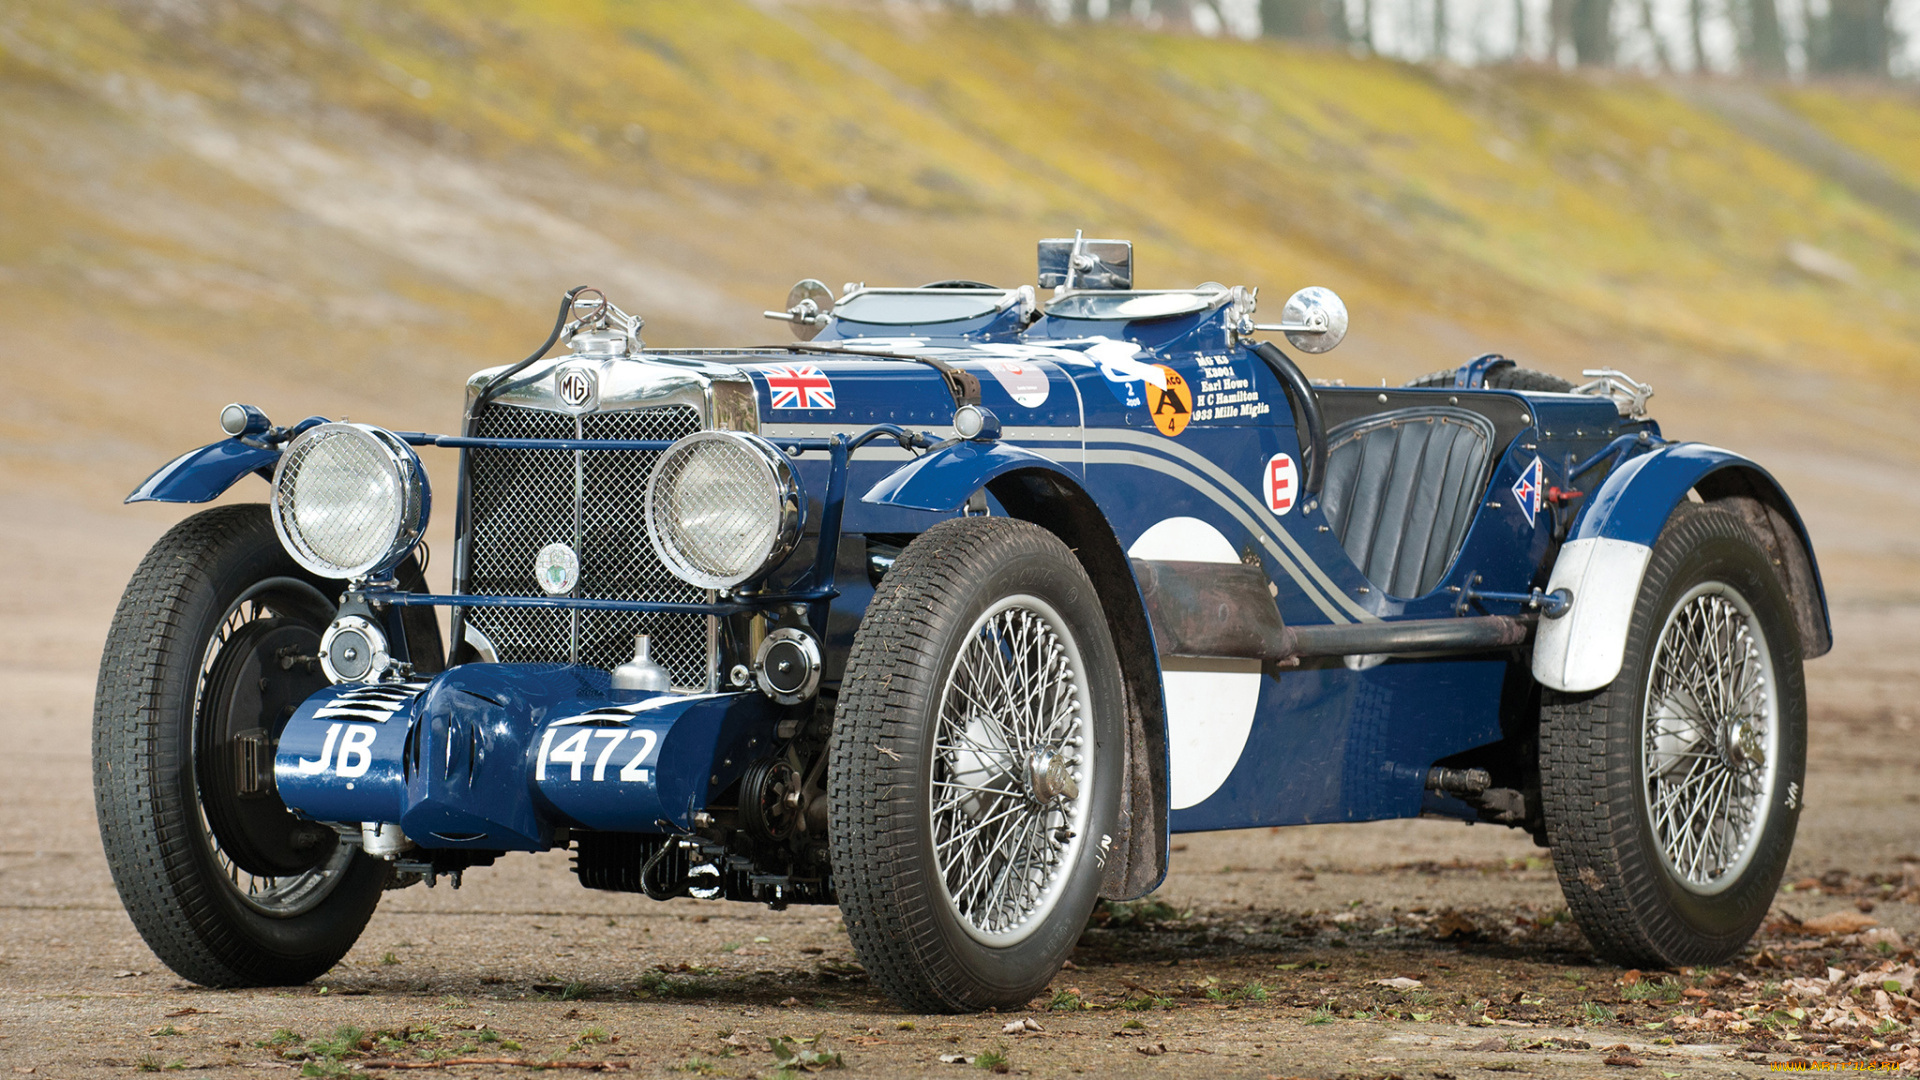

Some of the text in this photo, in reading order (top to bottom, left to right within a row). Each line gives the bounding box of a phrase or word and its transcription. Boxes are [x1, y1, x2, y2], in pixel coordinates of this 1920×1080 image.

[1195, 356, 1214, 367] MG
[562, 376, 585, 401] MG
[1125, 382, 1135, 396] 2
[1201, 378, 1249, 393] Earl Howe
[1153, 388, 1190, 415] A
[1197, 390, 1259, 407] H C Hamilton
[1214, 405, 1239, 419] Mille
[1239, 401, 1270, 418] Miglia
[1168, 417, 1175, 432] 4
[1271, 458, 1290, 510] E
[299, 723, 378, 778] JB
[534, 728, 658, 782] 1472
